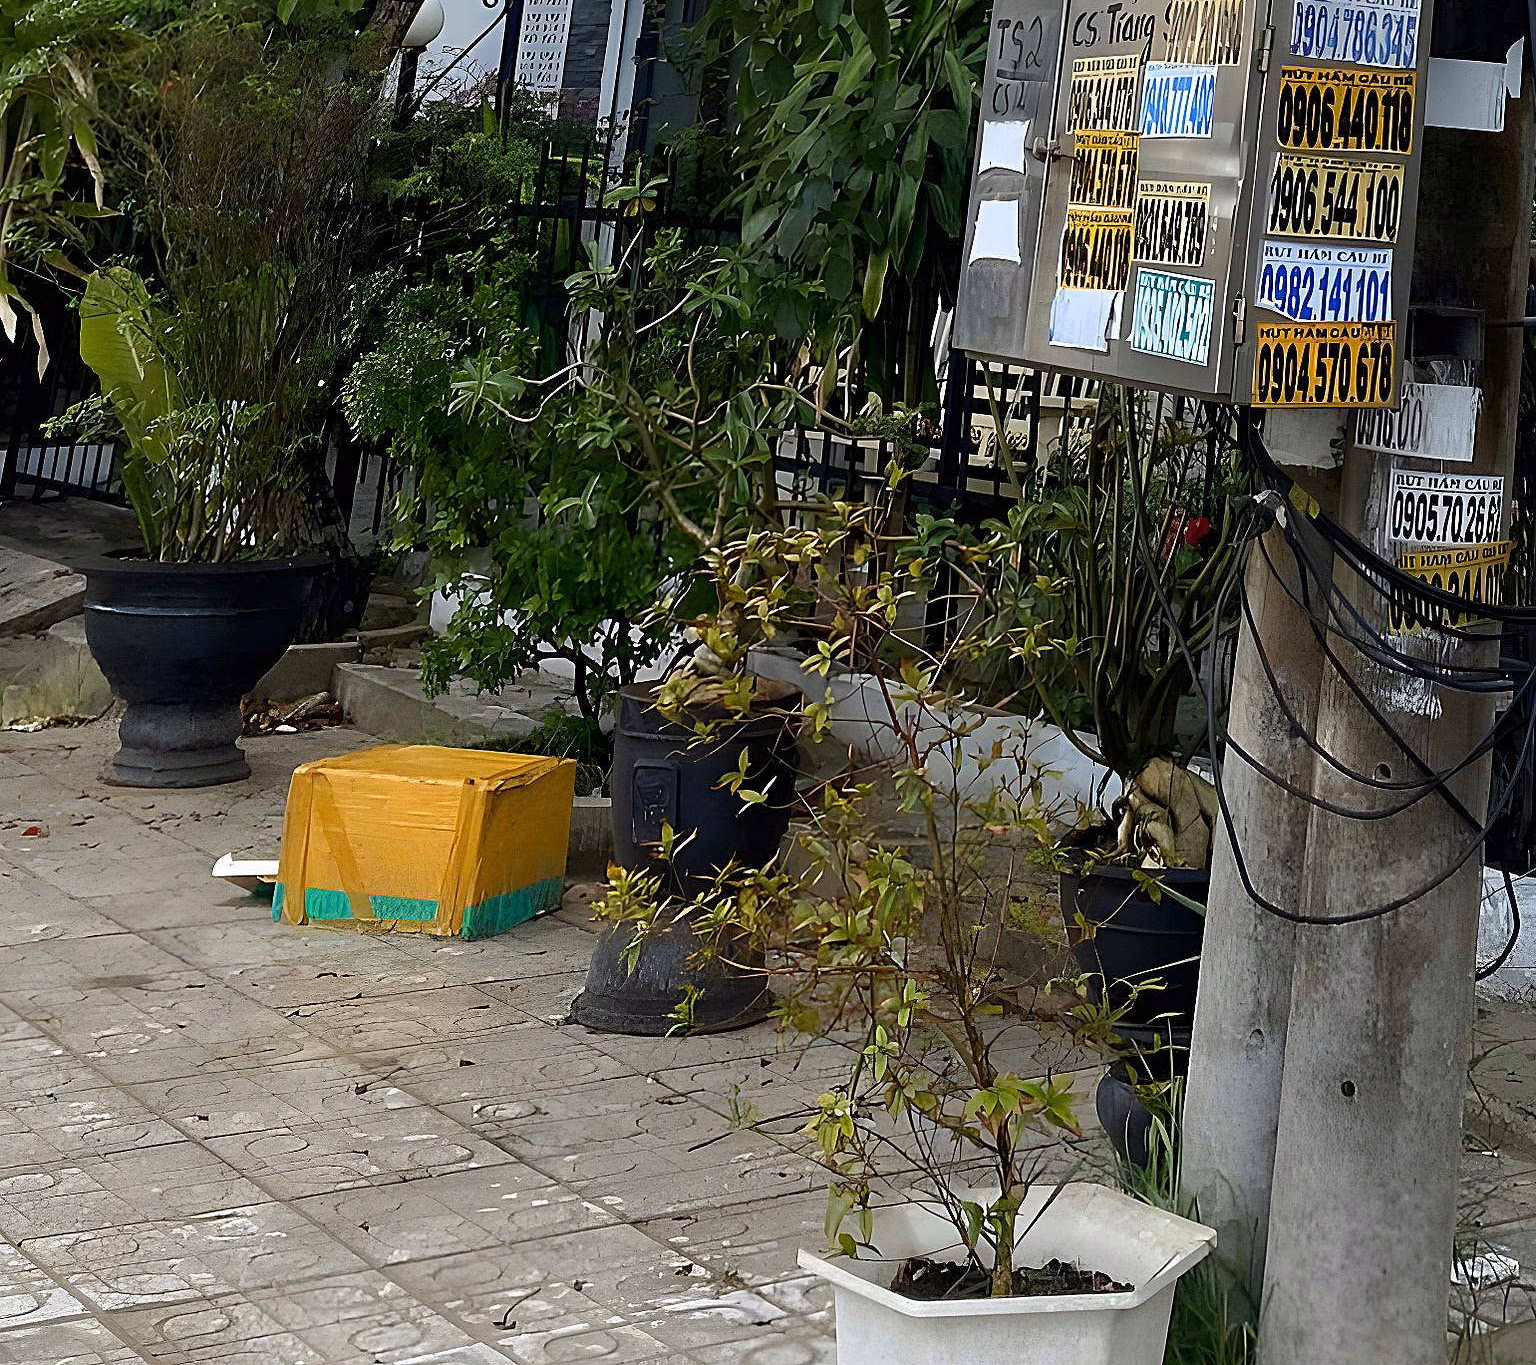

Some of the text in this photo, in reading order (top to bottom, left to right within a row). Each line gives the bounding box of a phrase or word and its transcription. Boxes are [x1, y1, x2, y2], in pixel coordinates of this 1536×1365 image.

[1277, 81, 1413, 153] 0906.440.118
[1260, 262, 1391, 321] 0982.141.101
[1257, 341, 1393, 403] 0904.570.678
